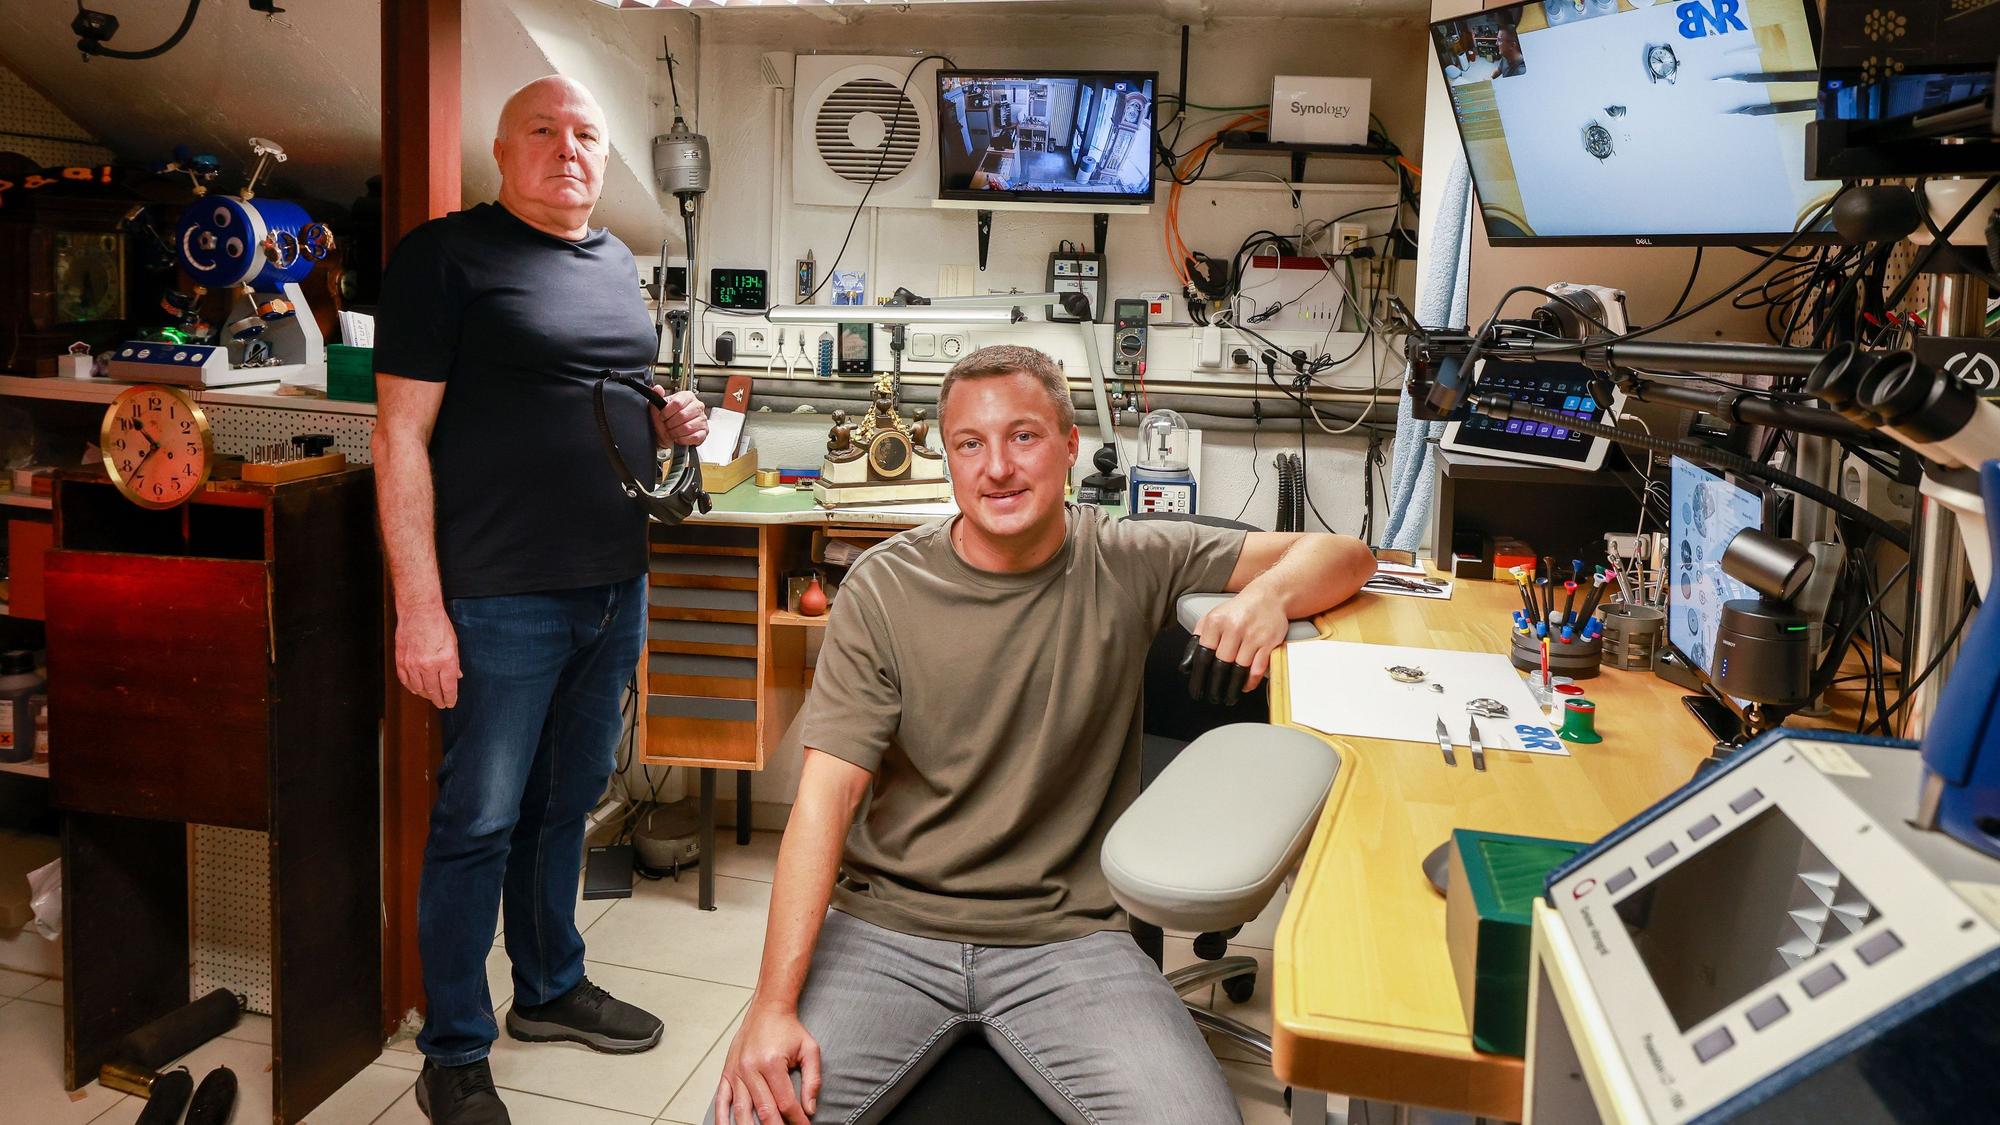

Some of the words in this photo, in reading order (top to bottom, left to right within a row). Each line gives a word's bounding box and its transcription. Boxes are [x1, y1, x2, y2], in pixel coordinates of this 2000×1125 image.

[1290, 101, 1351, 118] Synology
[132, 404, 141, 418] 11
[149, 397, 162, 411] 12
[170, 406, 175, 419] 1
[180, 421, 191, 435] 2
[116, 439, 126, 452] 9
[187, 442, 197, 456] 3
[123, 460, 133, 473] 8
[182, 463, 193, 477] 4
[136, 475, 144, 489] 7
[152, 482, 163, 496] 6
[171, 477, 181, 490] 5
